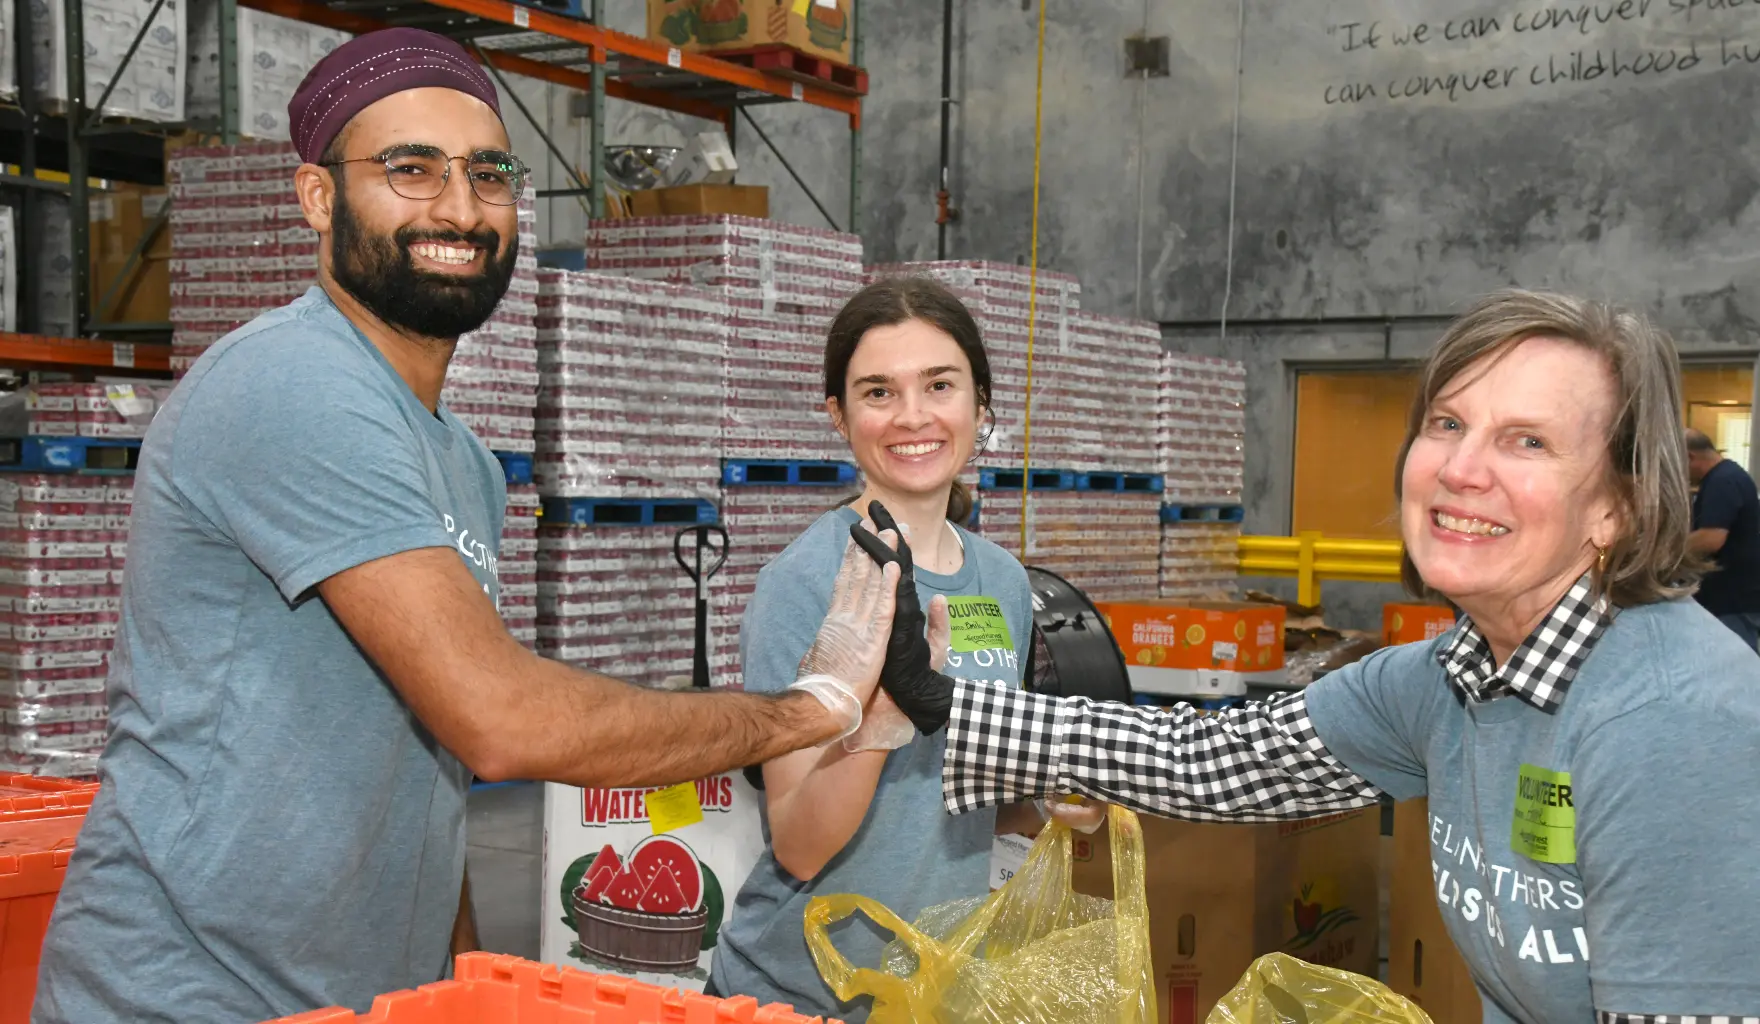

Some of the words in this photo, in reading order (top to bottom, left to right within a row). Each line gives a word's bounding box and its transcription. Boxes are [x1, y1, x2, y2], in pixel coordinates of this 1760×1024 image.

[1392, 22, 1430, 46] we
[1444, 16, 1500, 41] can
[1512, 0, 1650, 35] conquer
[1323, 81, 1378, 105] can
[1387, 65, 1519, 102] conquer
[1529, 38, 1702, 86] childhood
[947, 602, 1003, 619] OLUNTEER
